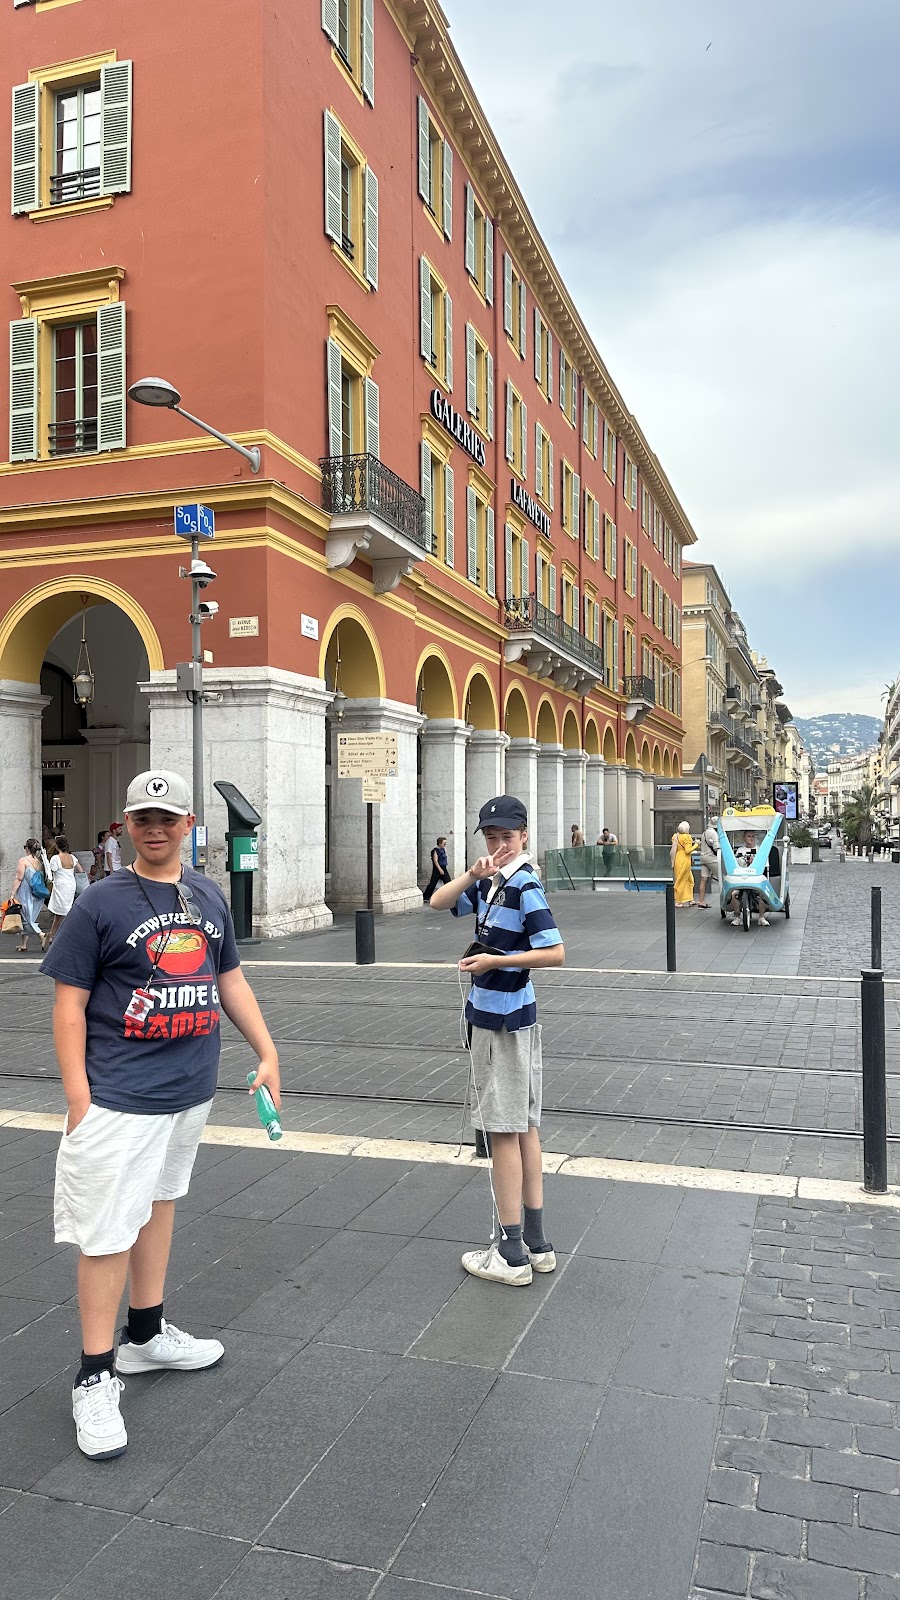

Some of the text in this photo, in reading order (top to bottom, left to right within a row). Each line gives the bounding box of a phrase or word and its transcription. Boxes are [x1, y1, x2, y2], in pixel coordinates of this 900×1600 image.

[431, 388, 487, 467] GALERIES
[177, 506, 197, 532] SOS
[199, 505, 213, 537] SOS
[511, 478, 552, 538] LAFAYETTE
[204, 920, 222, 939] BY
[132, 985, 208, 1009] NIME
[123, 1010, 220, 1039] RAMEN
